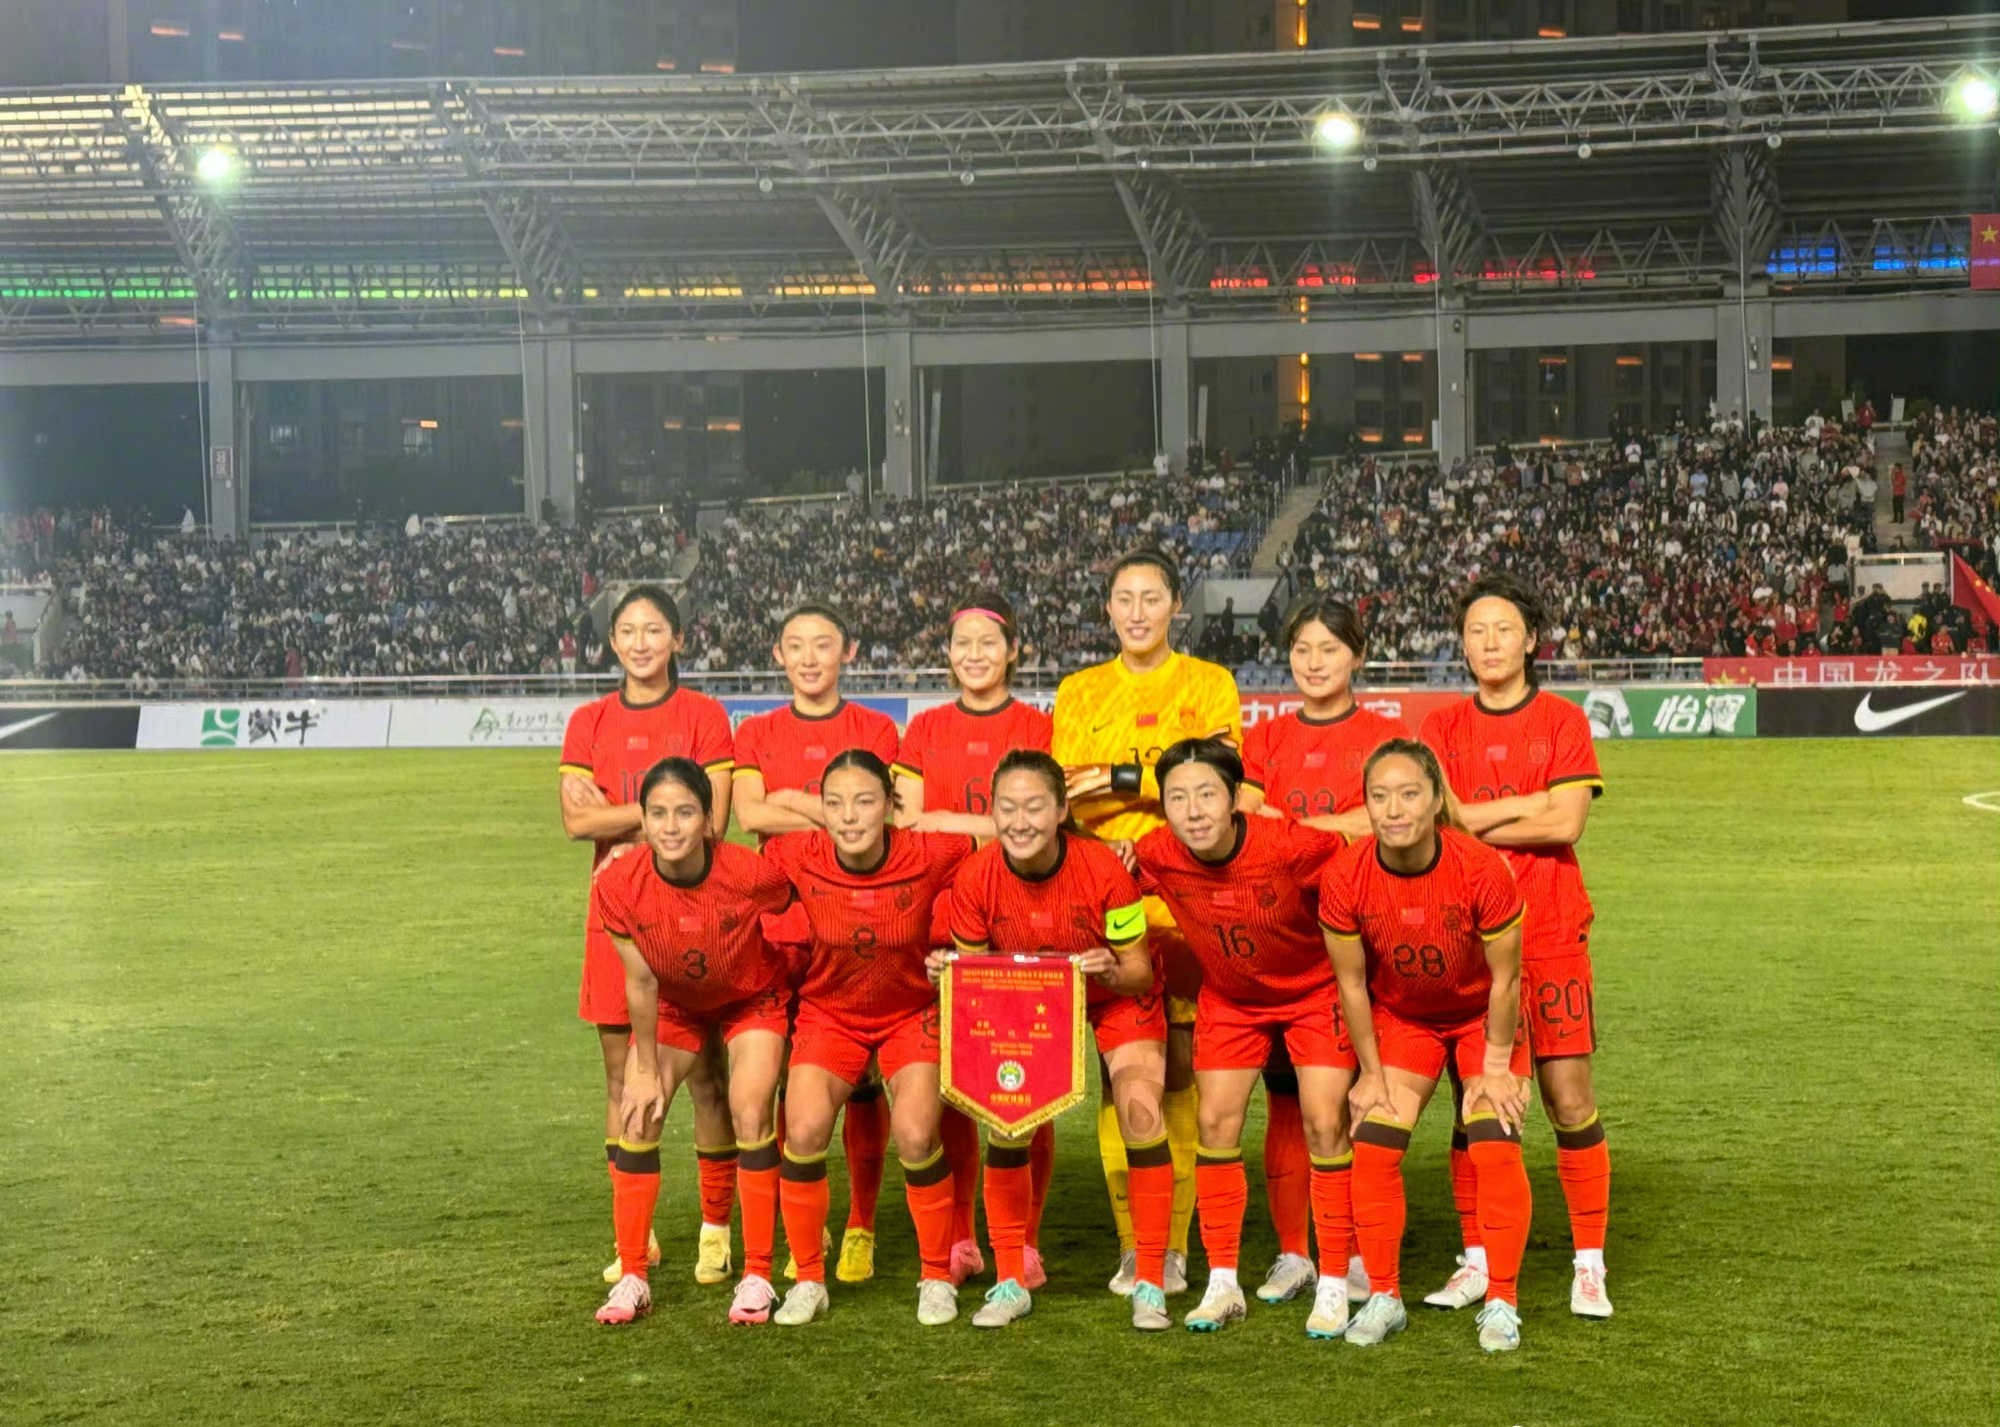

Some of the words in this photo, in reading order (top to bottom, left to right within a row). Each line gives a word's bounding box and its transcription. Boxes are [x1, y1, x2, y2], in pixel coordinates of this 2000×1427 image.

[1773, 660, 1993, 688] 中国龙之队
[247, 707, 321, 746] 蒙牛
[965, 777, 988, 814] 6
[852, 926, 877, 959] 2
[1213, 923, 1256, 960] 16
[682, 948, 708, 980] 3
[1393, 943, 1447, 979] 28
[1537, 978, 1585, 1025] 20
